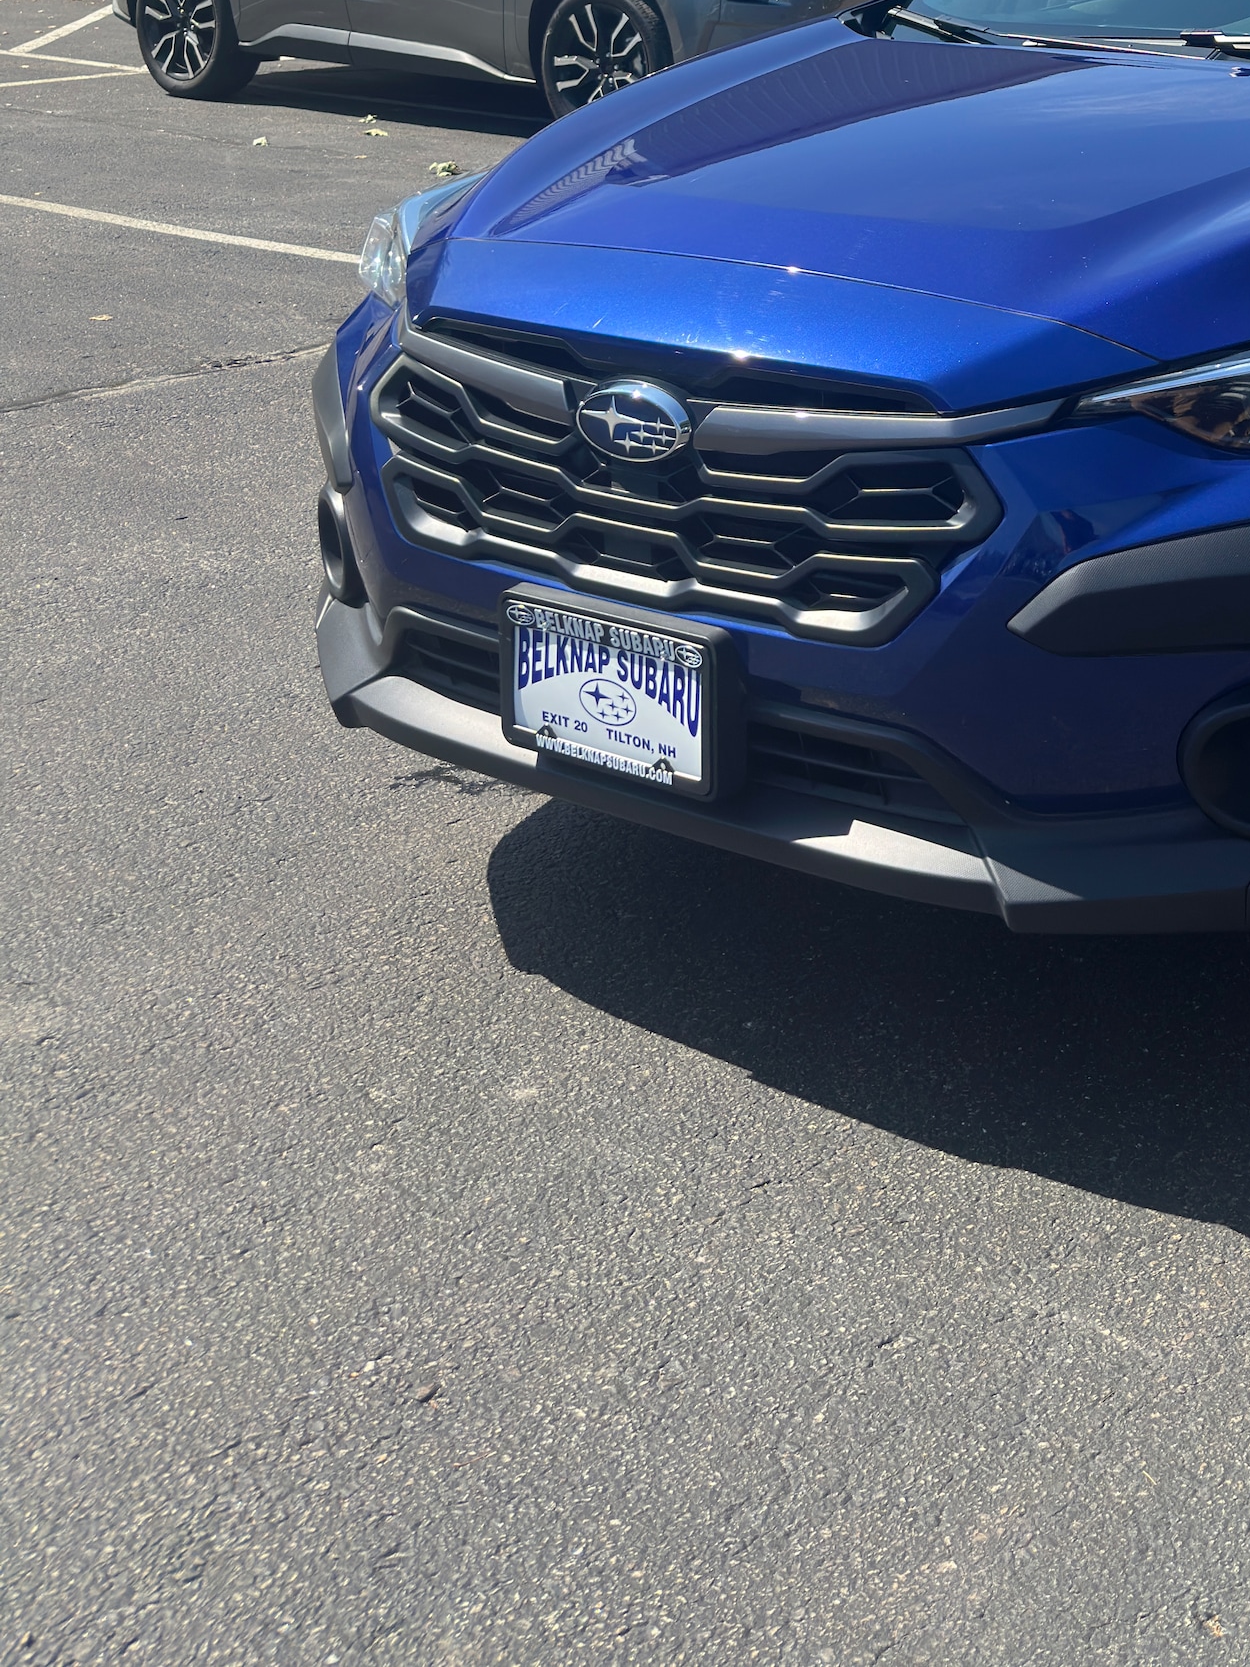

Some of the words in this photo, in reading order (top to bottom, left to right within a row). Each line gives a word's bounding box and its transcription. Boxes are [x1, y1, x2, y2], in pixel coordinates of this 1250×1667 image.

[534, 608, 604, 642] BELKNAP
[609, 626, 676, 662] SUBARU
[518, 627, 610, 690] BELKNAP
[616, 649, 701, 737] SUBARU
[542, 710, 570, 728] EXIT
[574, 720, 588, 733] 20
[606, 728, 654, 755] TILTON,
[658, 743, 676, 758] NH
[535, 733, 673, 785] WWW.BELKNAPSUBARU.COM
